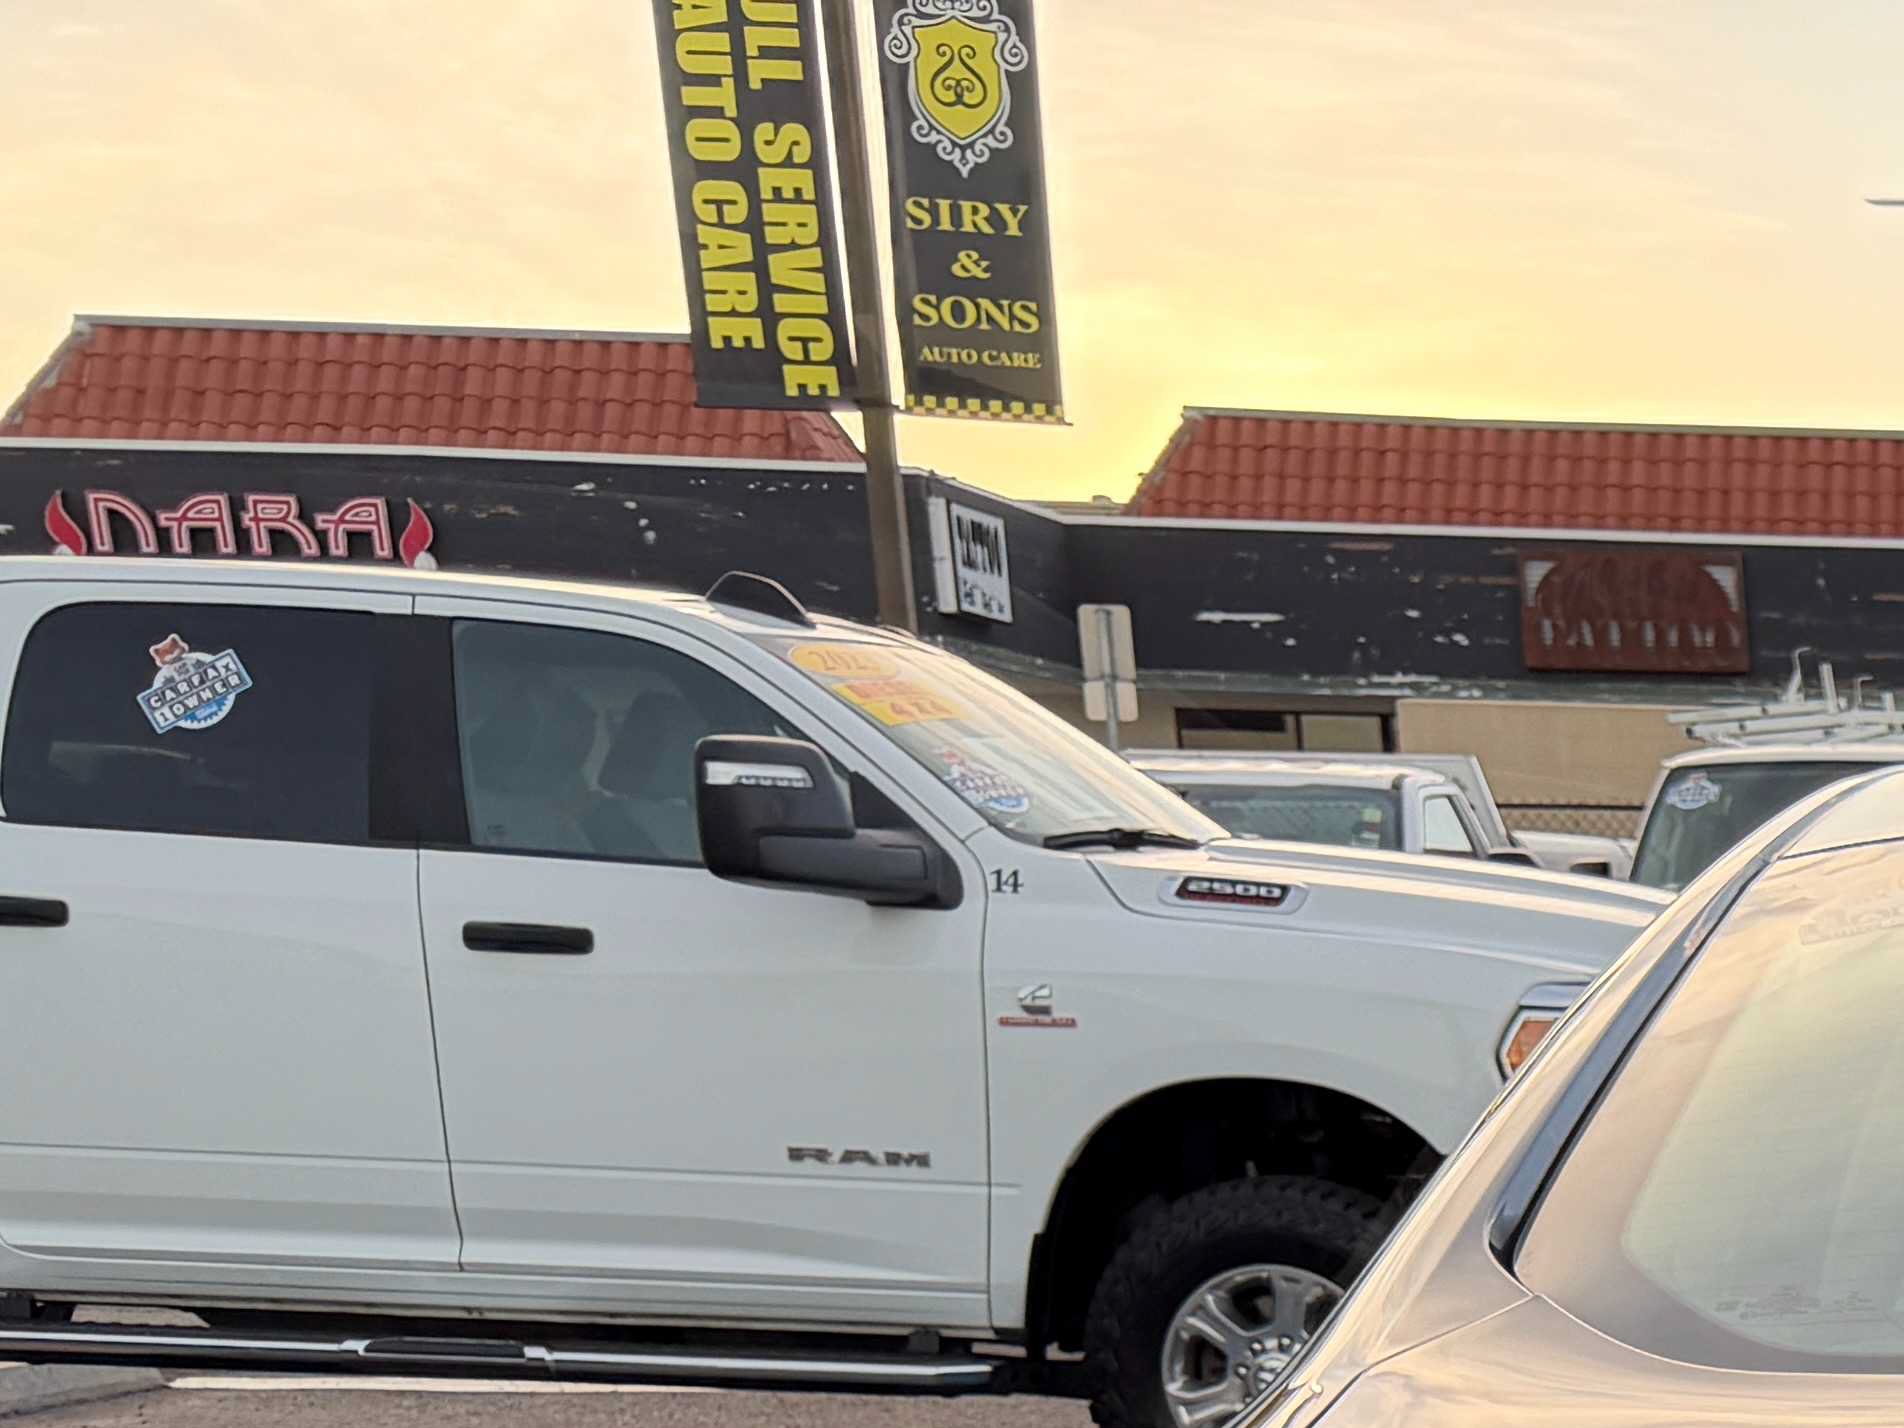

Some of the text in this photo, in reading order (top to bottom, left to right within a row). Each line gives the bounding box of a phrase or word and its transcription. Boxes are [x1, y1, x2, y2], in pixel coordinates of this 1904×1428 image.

[672, 0, 765, 350] AUTO CARE
[905, 196, 1029, 237] SIRY
[754, 122, 840, 398] SERVICE
[951, 249, 991, 280] &
[912, 293, 1041, 334] SONS
[919, 345, 1042, 369] AUTO CARE
[85, 489, 394, 560] NARA
[149, 660, 234, 708] CARFAX
[990, 868, 1024, 894] 14
[1187, 879, 1282, 898] 2500
[787, 1146, 931, 1168] RAM
